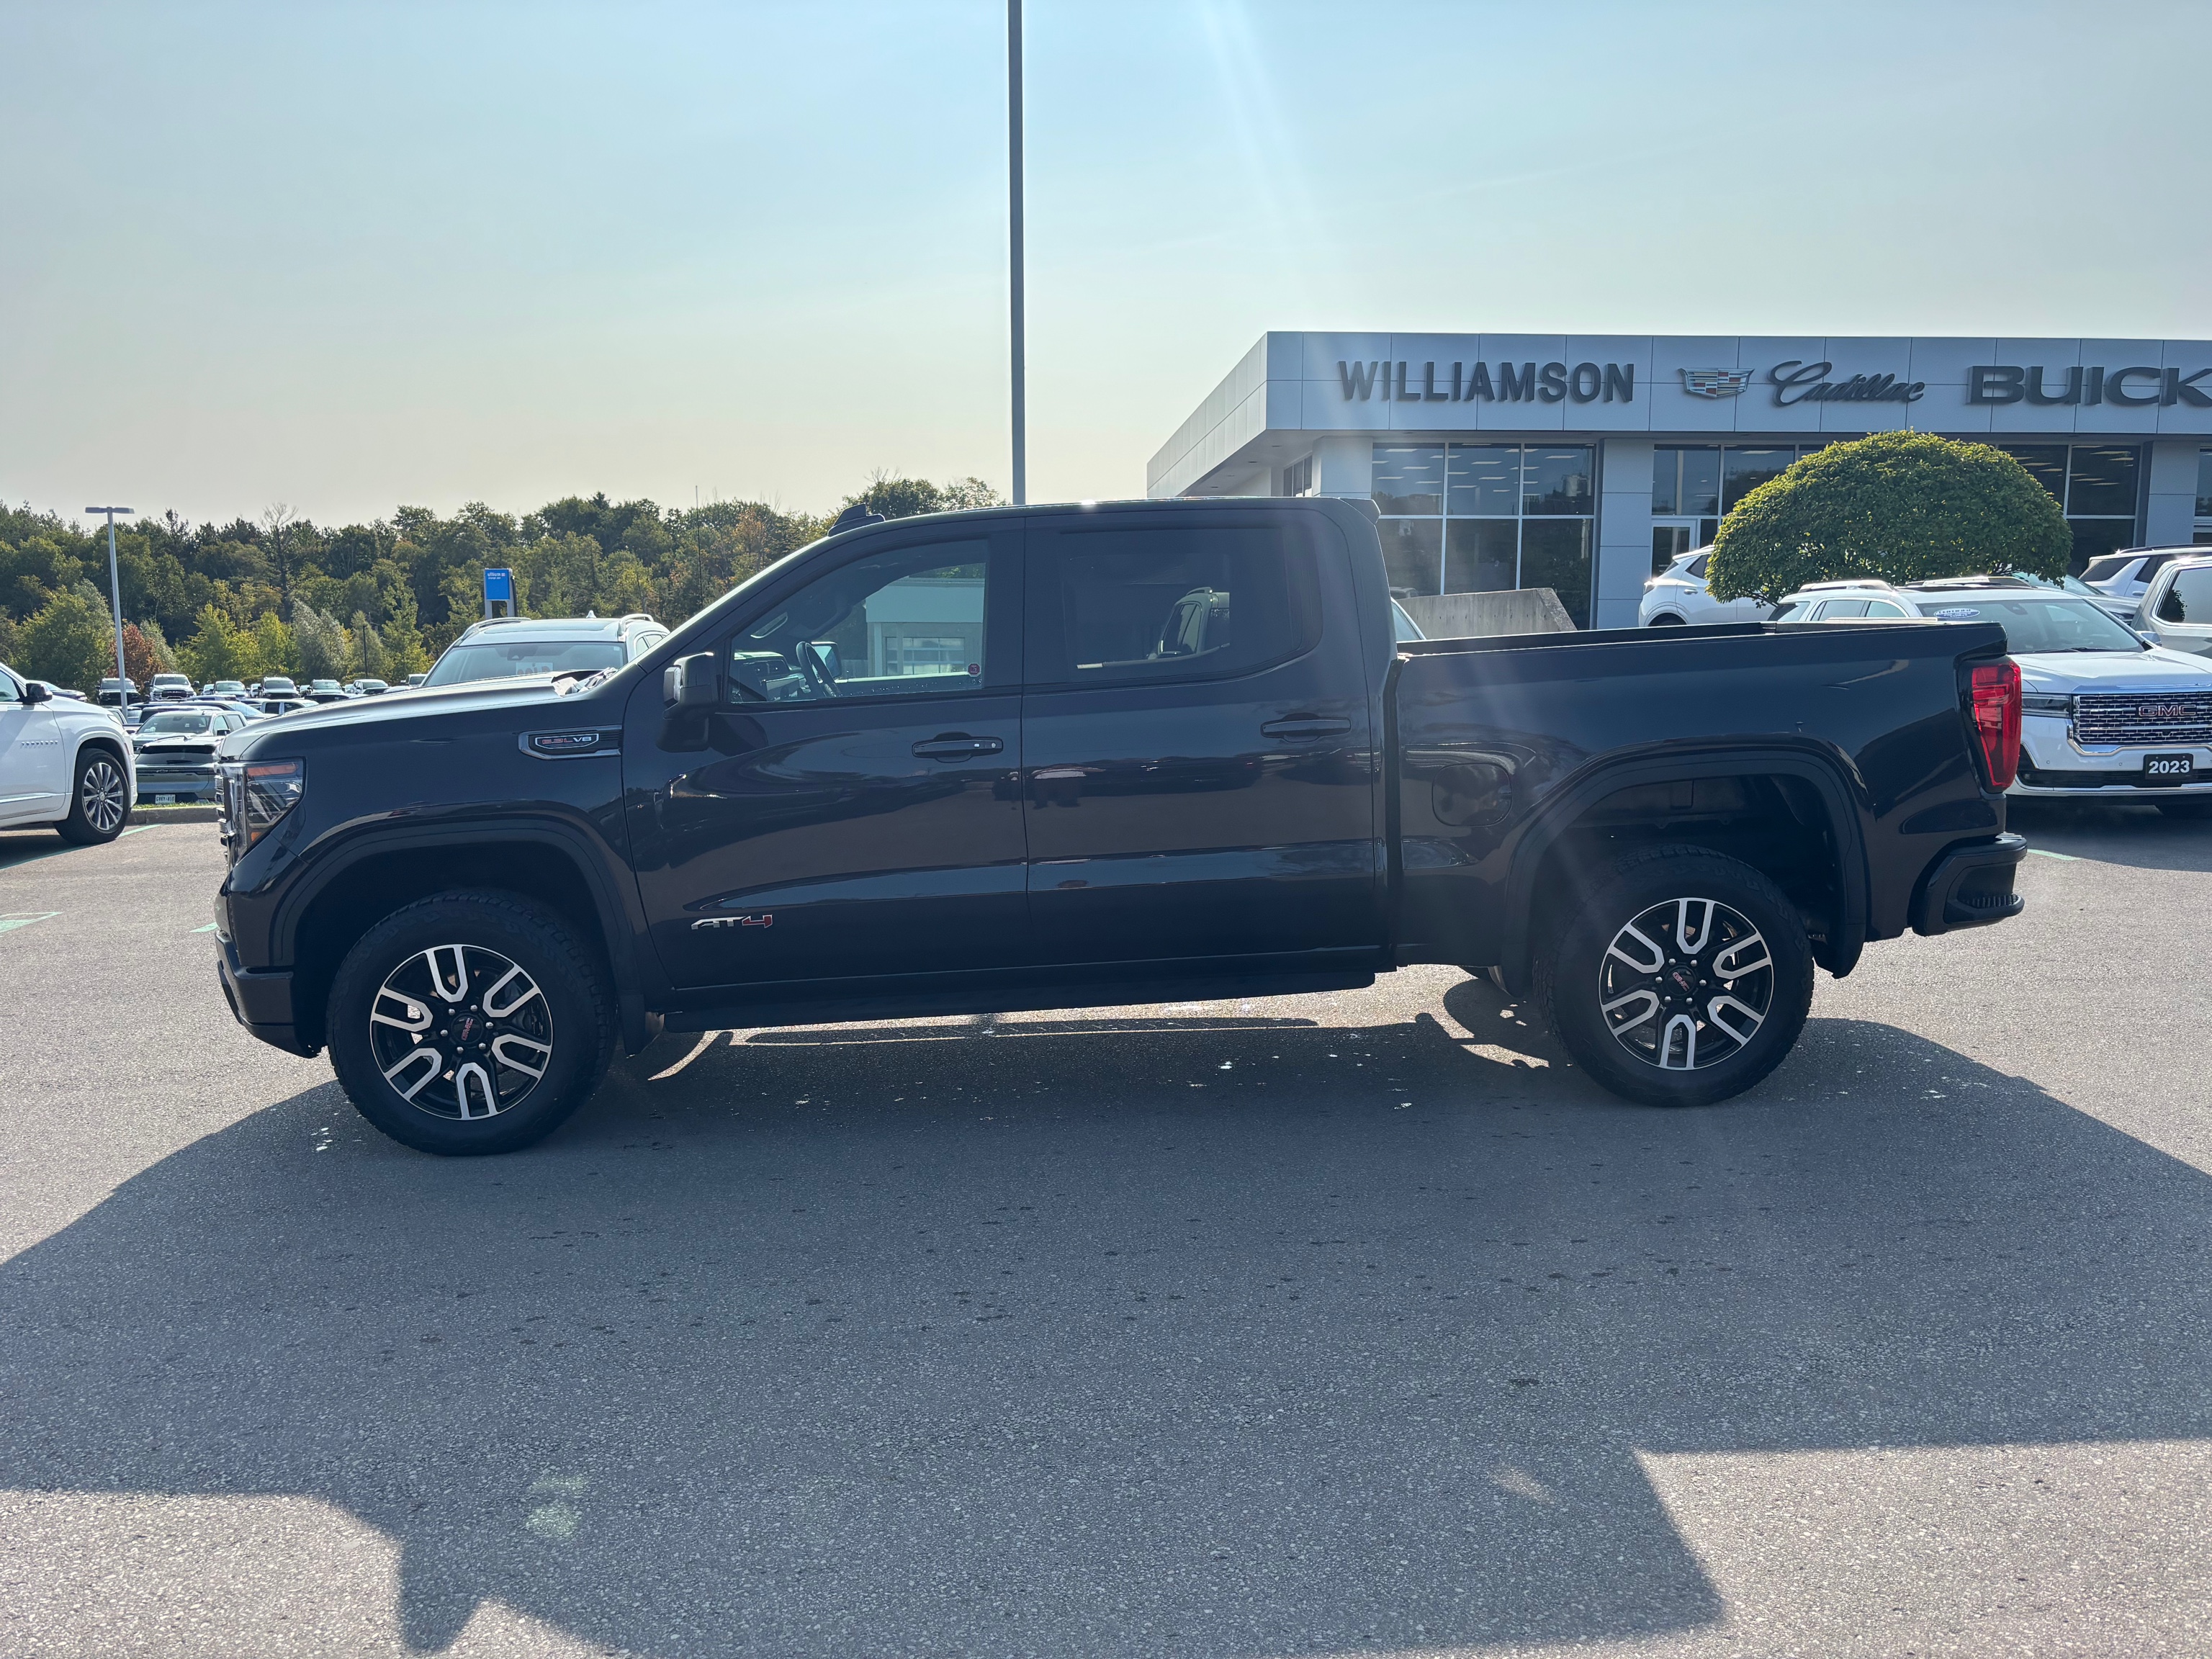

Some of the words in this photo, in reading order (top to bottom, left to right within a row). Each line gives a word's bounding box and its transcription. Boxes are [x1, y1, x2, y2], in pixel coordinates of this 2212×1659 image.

[1338, 361, 1635, 402] WILLIAMSON
[1768, 360, 1925, 406] Cadillac
[1966, 366, 2212, 407] BUICK
[2138, 704, 2196, 717] GMC
[2148, 760, 2190, 774] 2023
[691, 914, 773, 930] AT4
